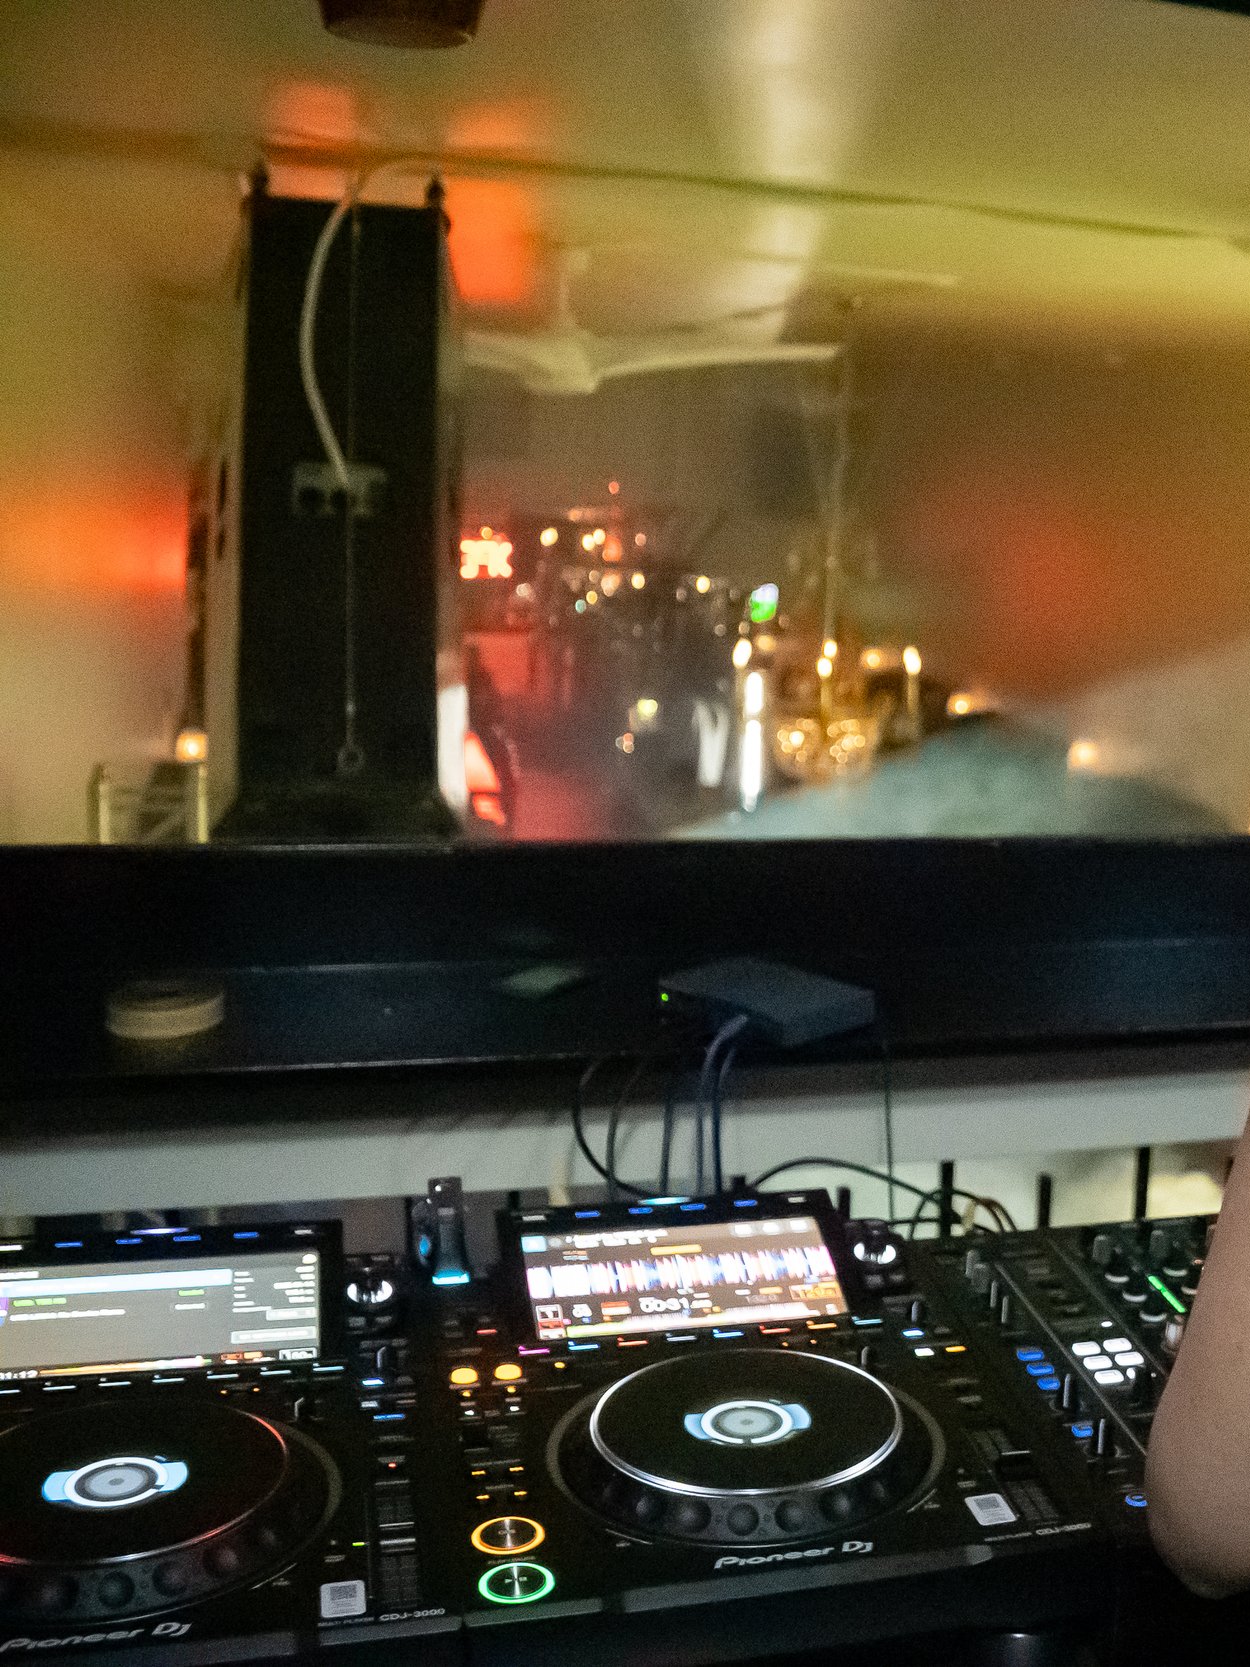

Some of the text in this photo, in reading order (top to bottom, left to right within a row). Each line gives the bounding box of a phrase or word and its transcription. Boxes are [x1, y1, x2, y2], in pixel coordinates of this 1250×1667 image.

[714, 1547, 835, 1569] Pioneer
[379, 1607, 446, 1622] CDJ-3000
[0, 1629, 144, 1650] Pioneer
